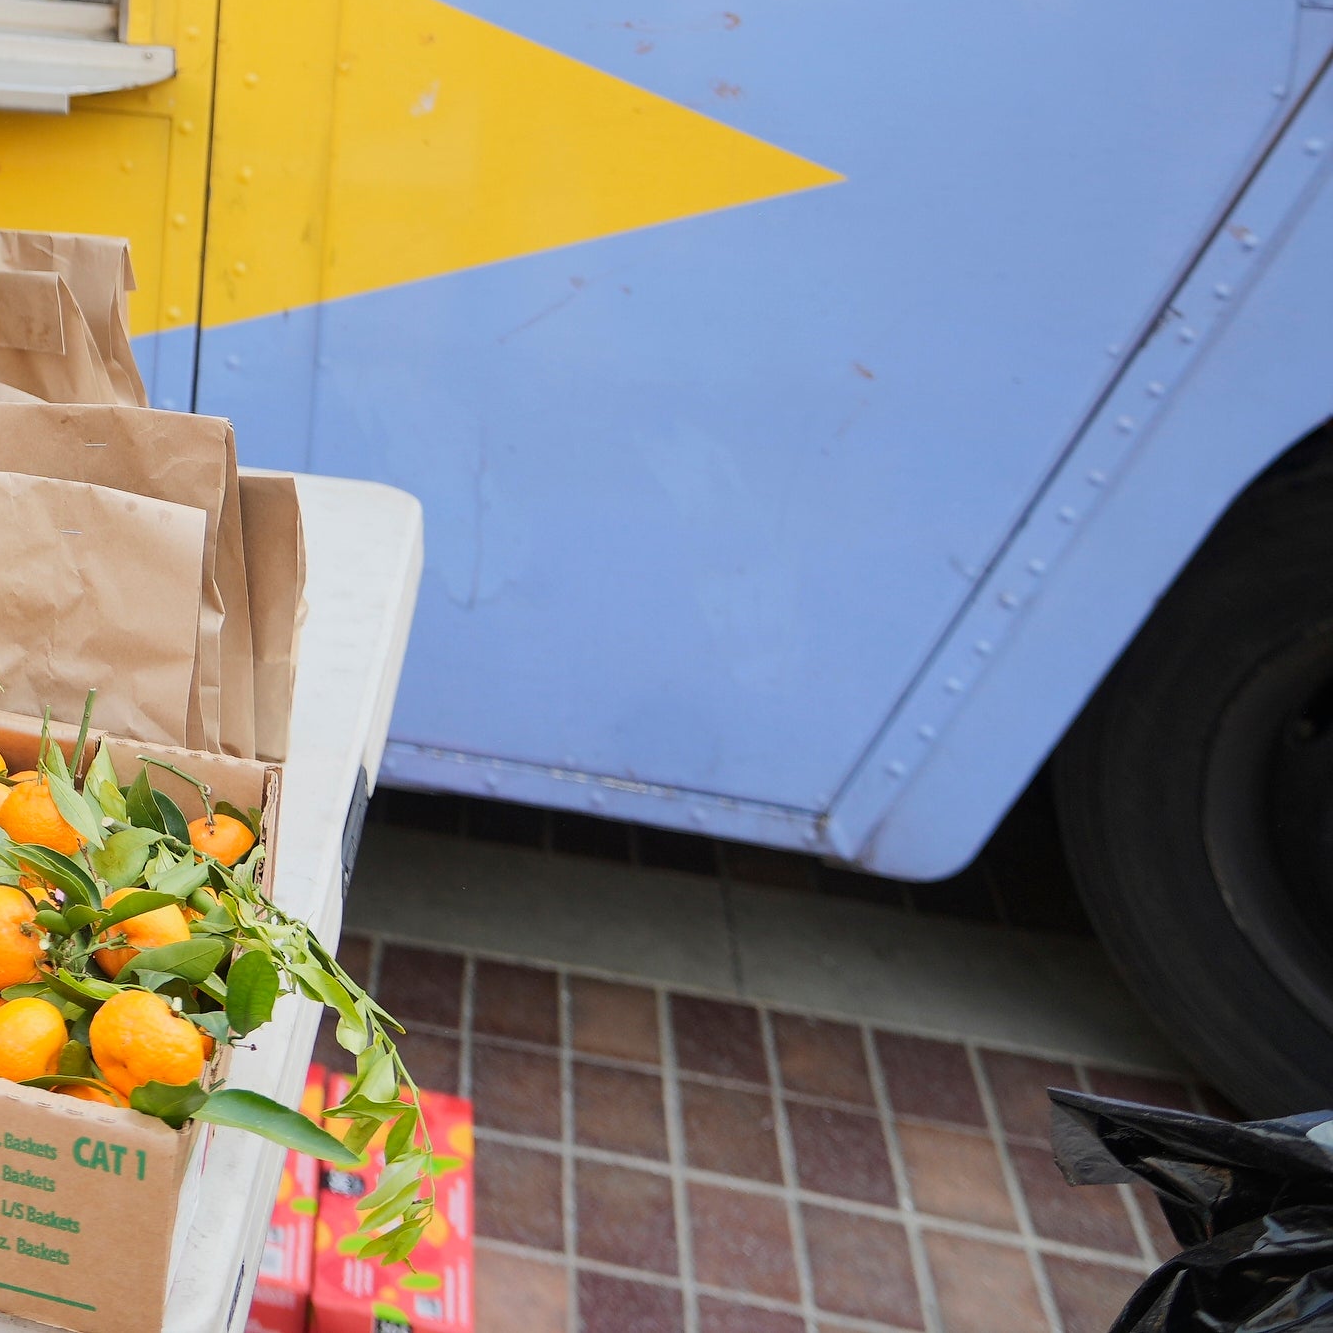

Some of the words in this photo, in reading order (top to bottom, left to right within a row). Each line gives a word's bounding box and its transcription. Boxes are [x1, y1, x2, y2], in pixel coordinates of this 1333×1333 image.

[4, 1134, 58, 1160] Baskets
[72, 1136, 127, 1176] CAT
[136, 1149, 146, 1181] 1
[2, 1166, 56, 1192] Baskets
[1, 1199, 24, 1220] L/S
[27, 1206, 80, 1234] Baskets
[17, 1237, 70, 1265] Baskets
